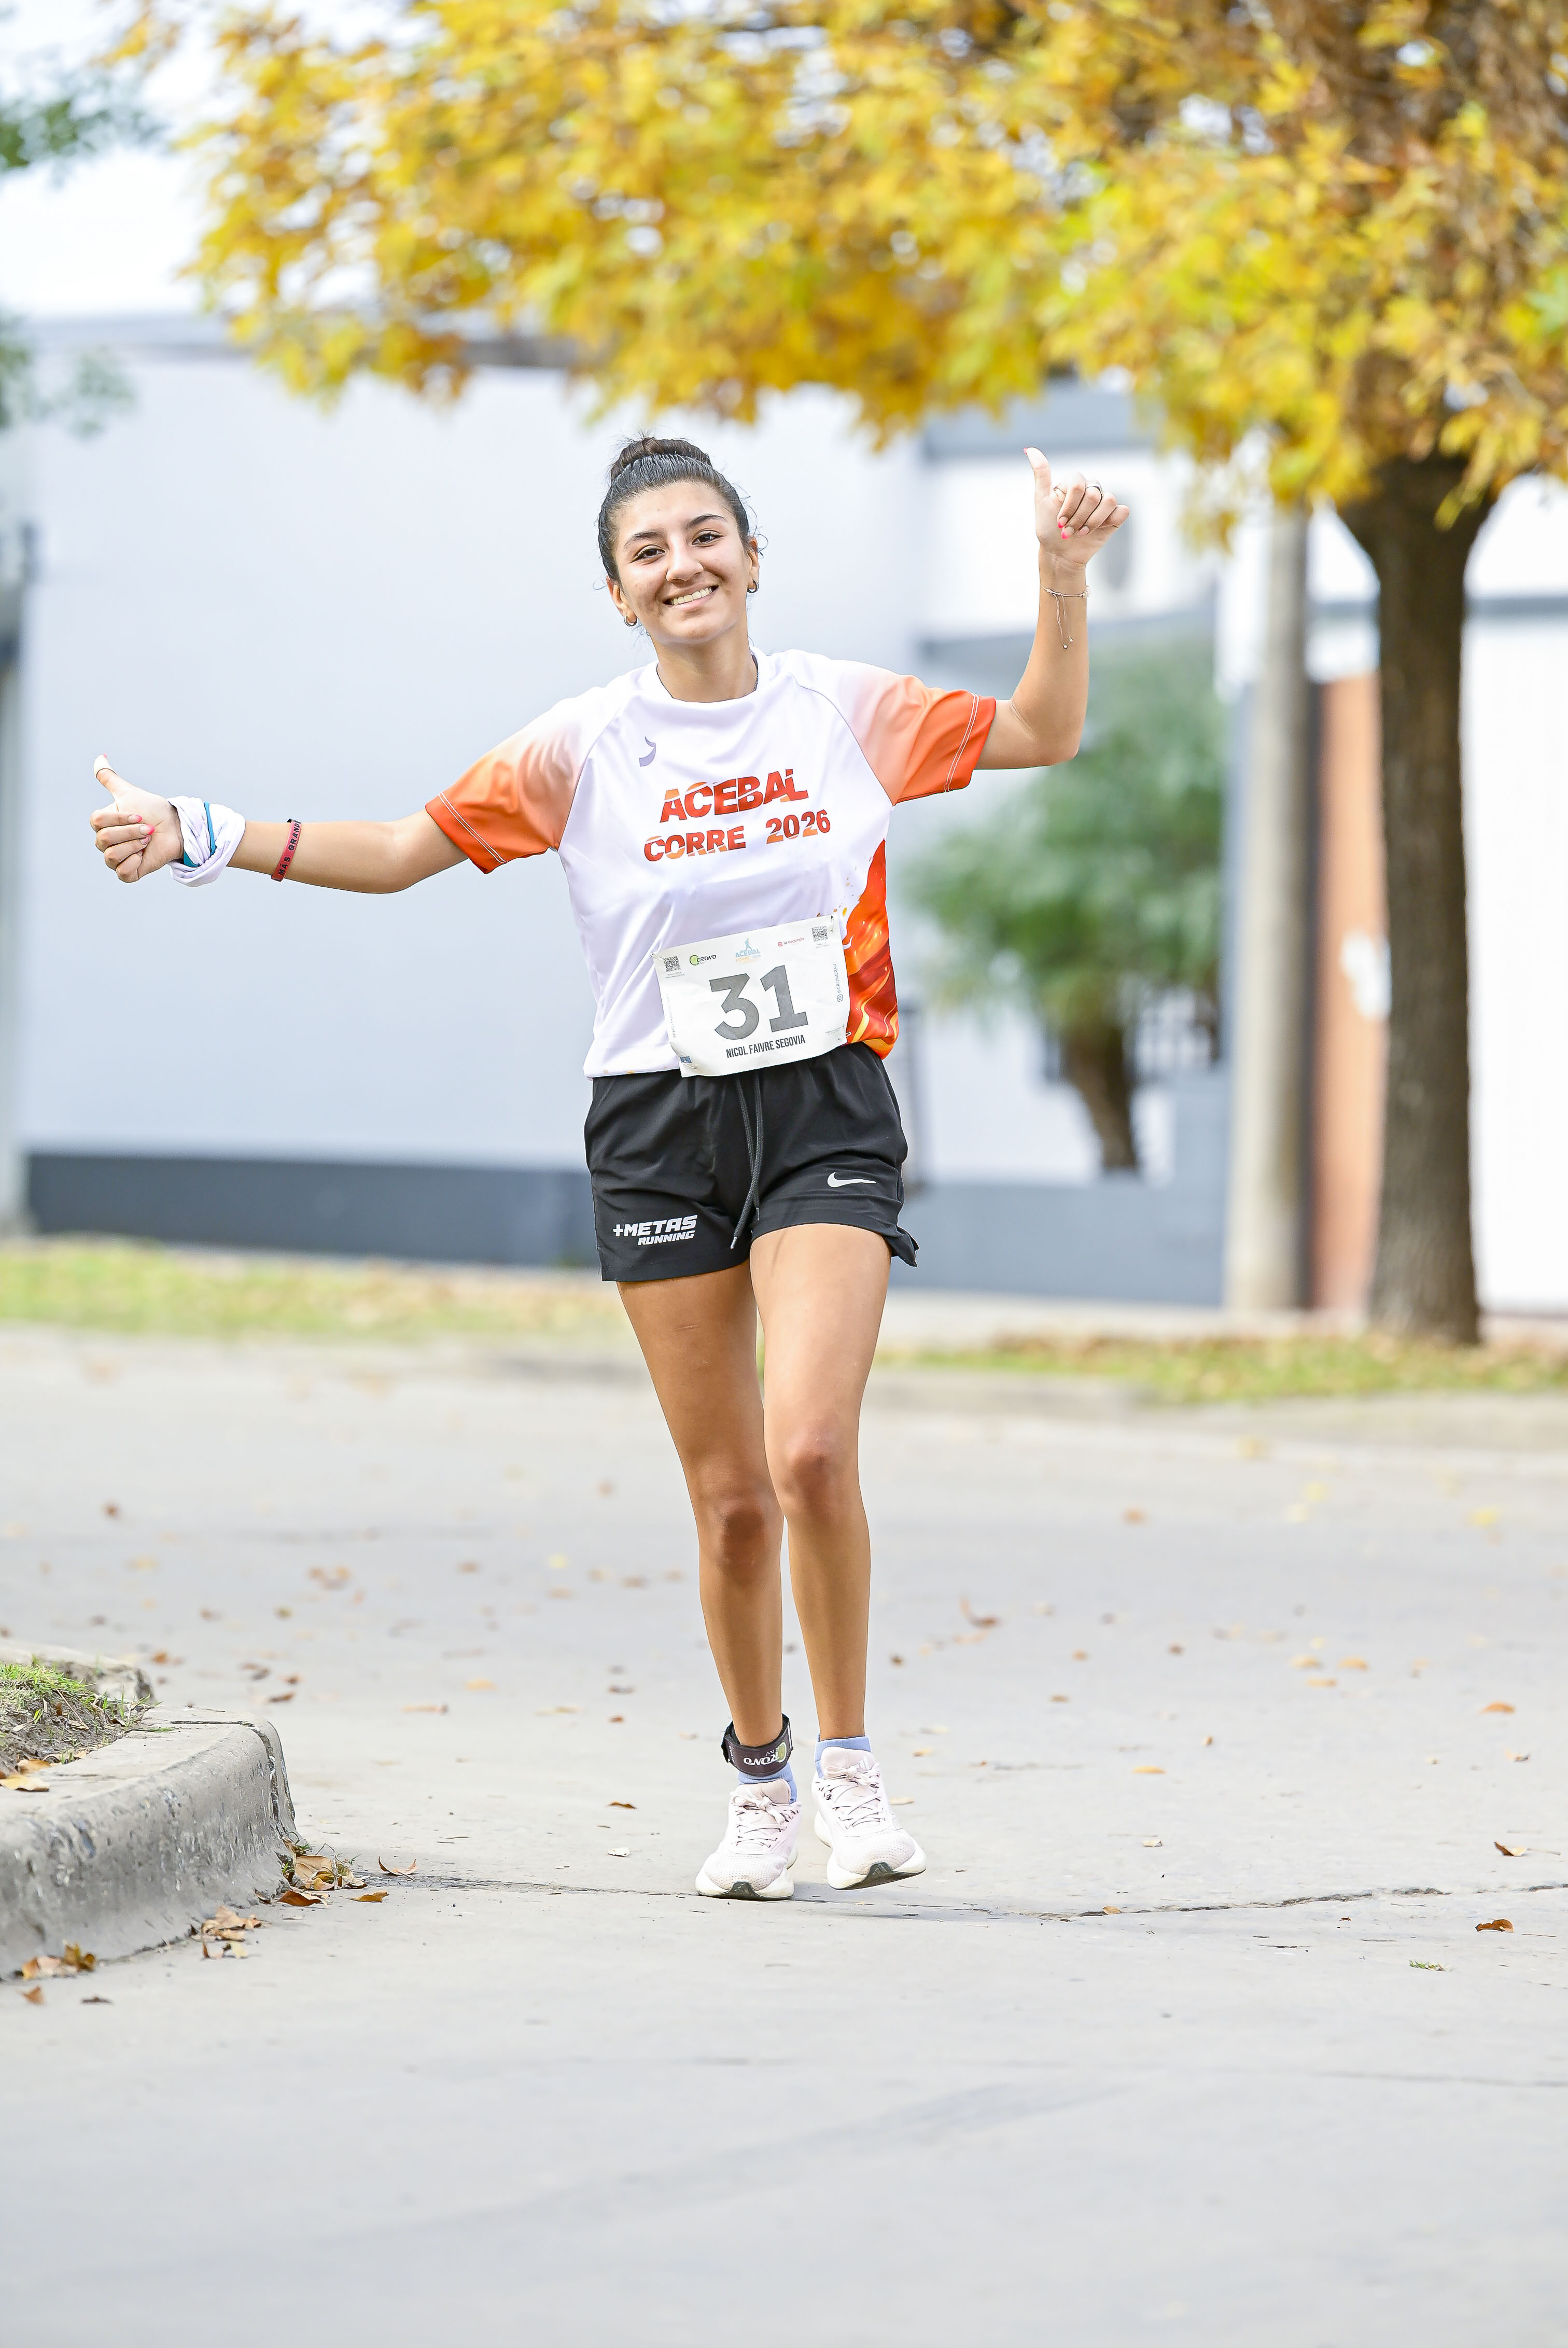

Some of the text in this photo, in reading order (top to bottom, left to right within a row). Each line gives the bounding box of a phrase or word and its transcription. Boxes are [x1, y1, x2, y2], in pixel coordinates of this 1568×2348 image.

[660, 768, 809, 823] ACEBAL
[644, 809, 831, 862] CORRE 2026
[709, 965, 809, 1040] 31
[726, 1035, 806, 1058] NICOL FAIVRE SEGOVIA
[637, 1230, 695, 1246] RUNNING
